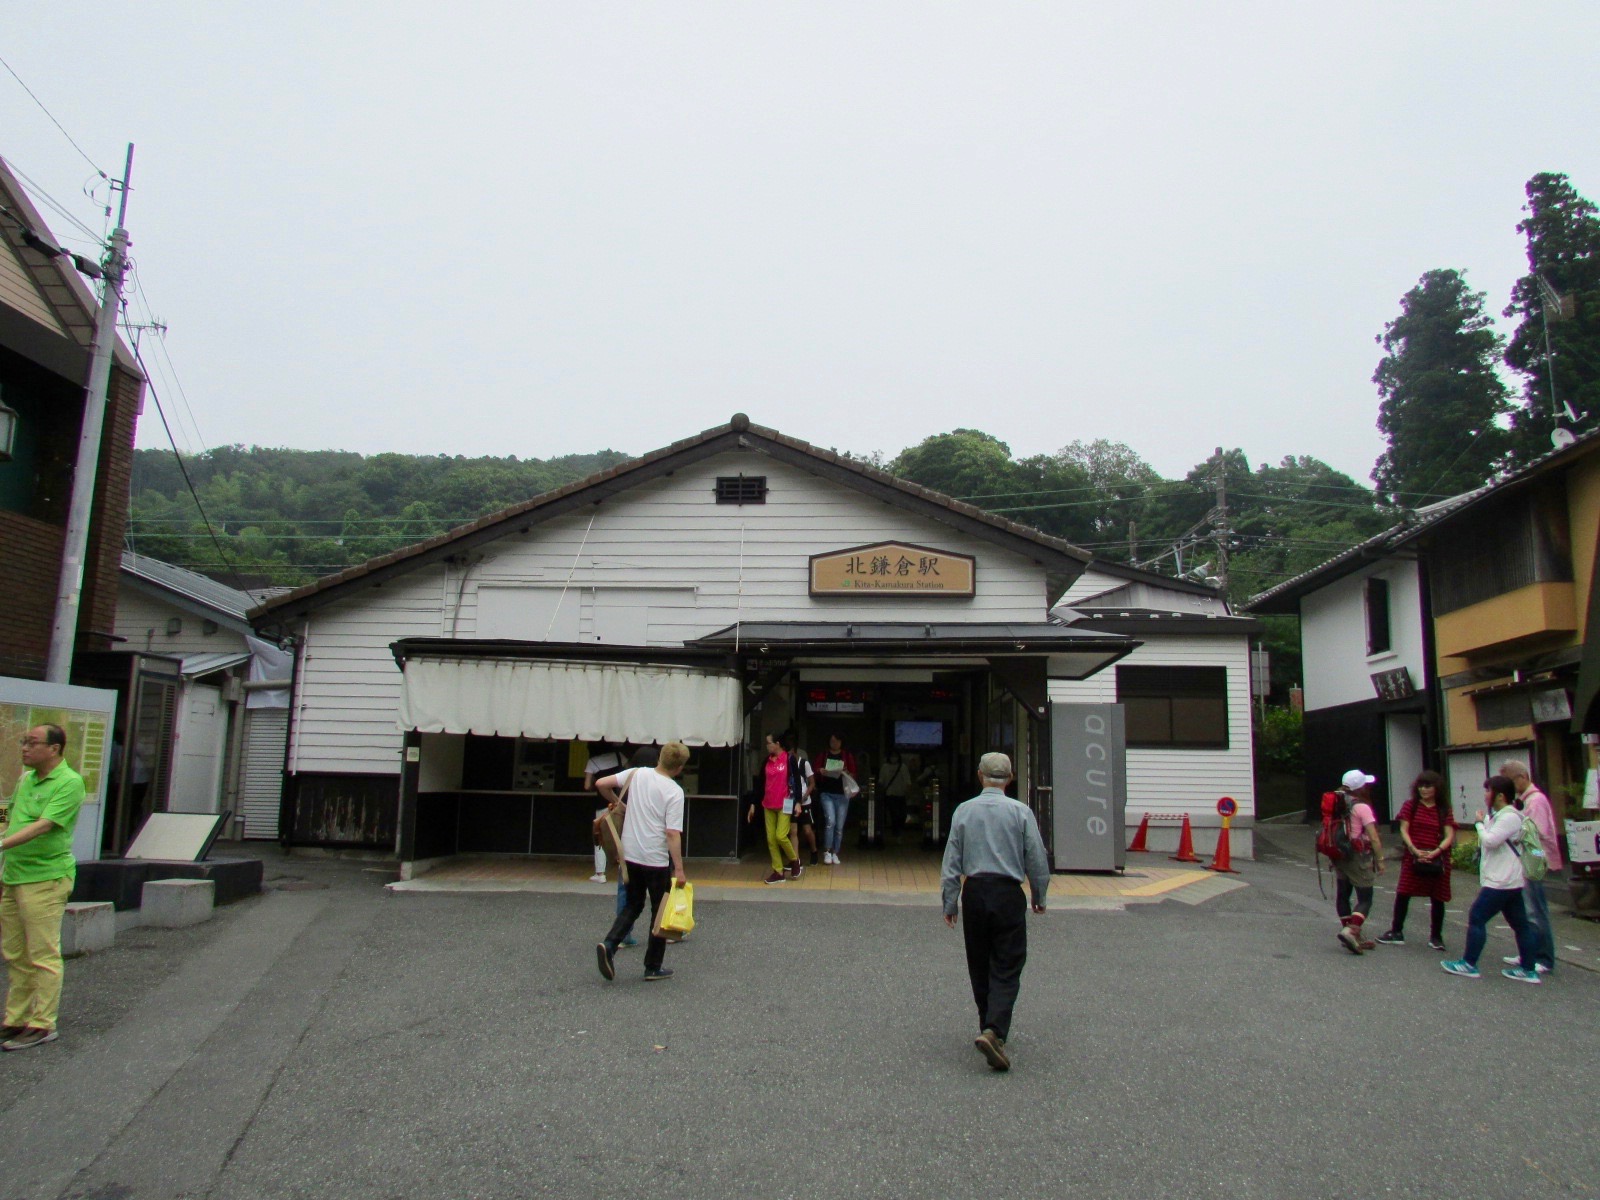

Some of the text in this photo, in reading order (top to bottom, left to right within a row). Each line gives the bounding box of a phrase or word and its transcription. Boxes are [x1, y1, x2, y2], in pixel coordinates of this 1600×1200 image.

[846, 555, 940, 576] 北鎌倉駅
[854, 580, 914, 589] Kita-Kamakura
[916, 580, 944, 589] Station
[1085, 714, 1107, 836] acure
